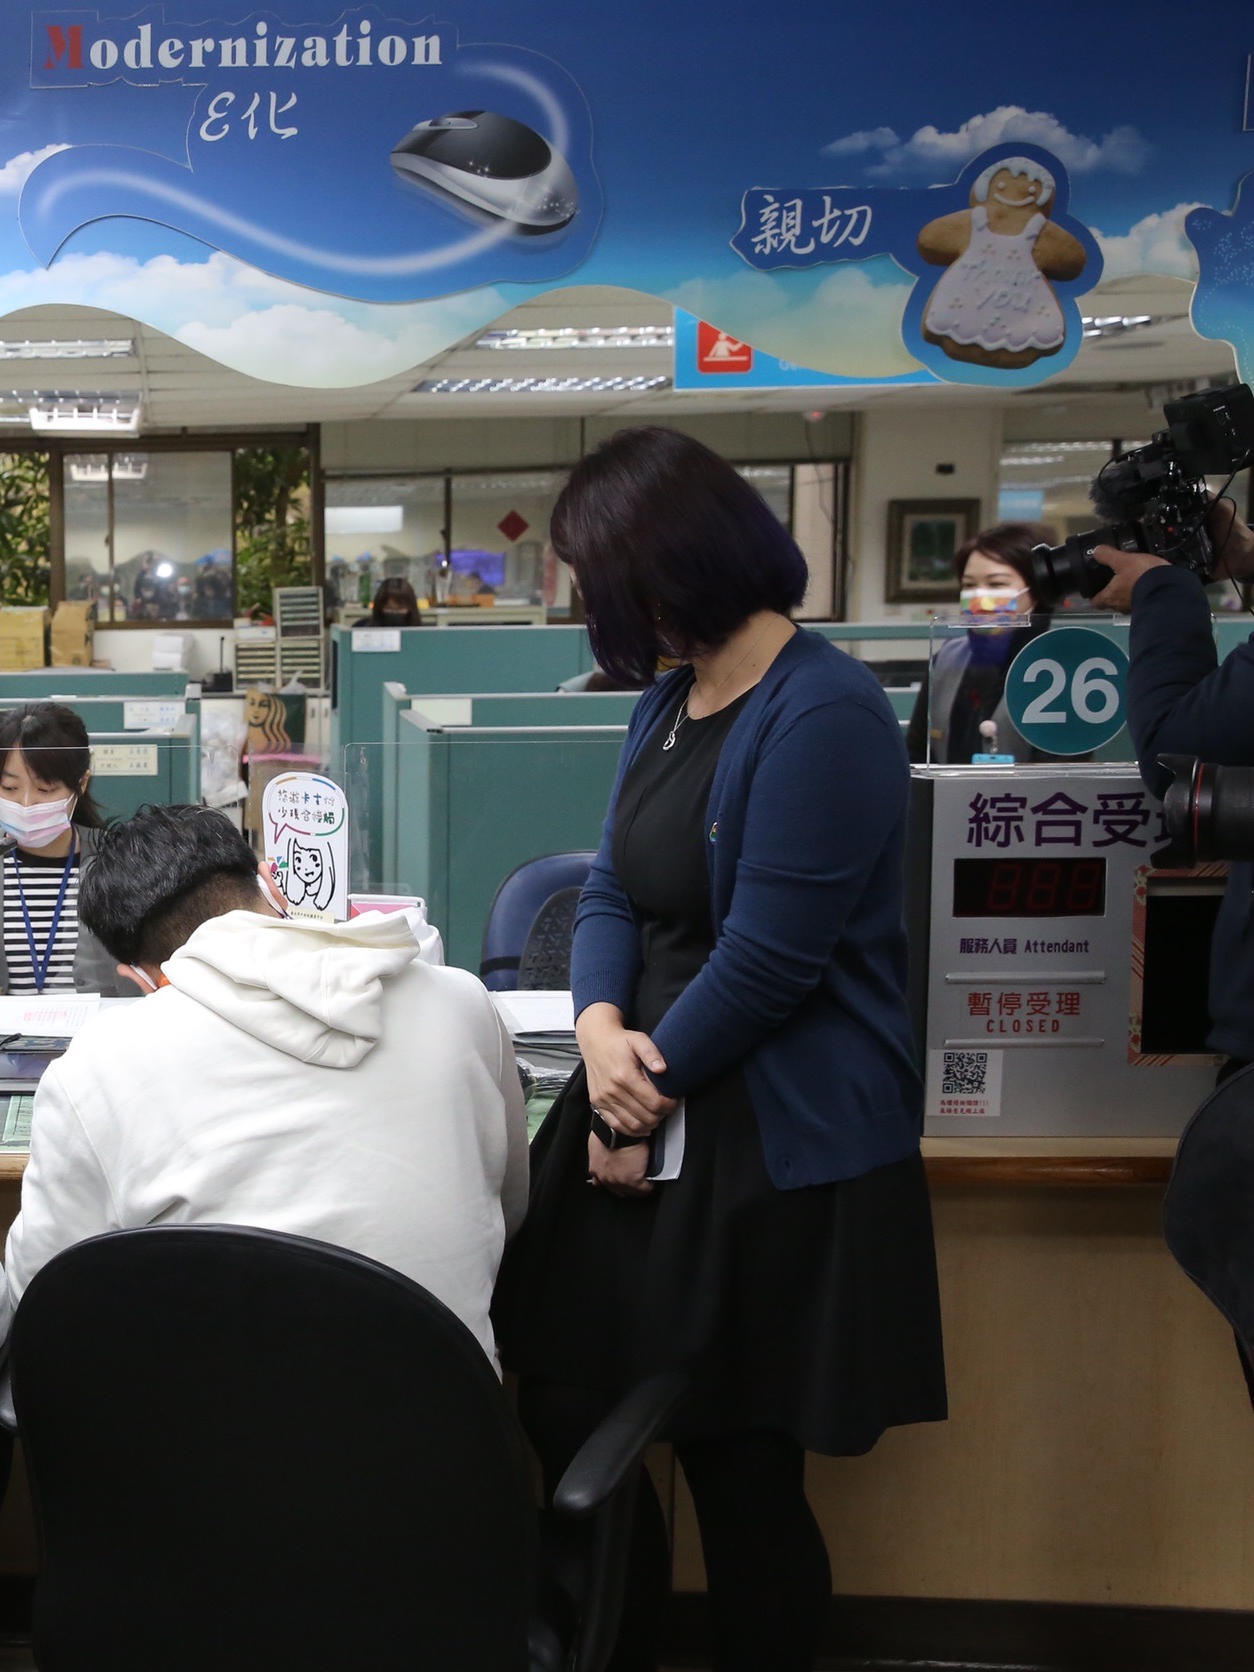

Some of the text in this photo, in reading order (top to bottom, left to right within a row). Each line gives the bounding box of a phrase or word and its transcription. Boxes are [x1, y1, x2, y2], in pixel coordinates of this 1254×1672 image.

[44, 20, 443, 70] Modernization
[751, 194, 873, 256] 親切
[1021, 658, 1120, 724] 26
[966, 792, 1173, 849] 綜合受
[959, 938, 1089, 954] 服務人員 Attendant
[968, 992, 1081, 1016] 暫停受理
[986, 1019, 1060, 1033] CLOSED
